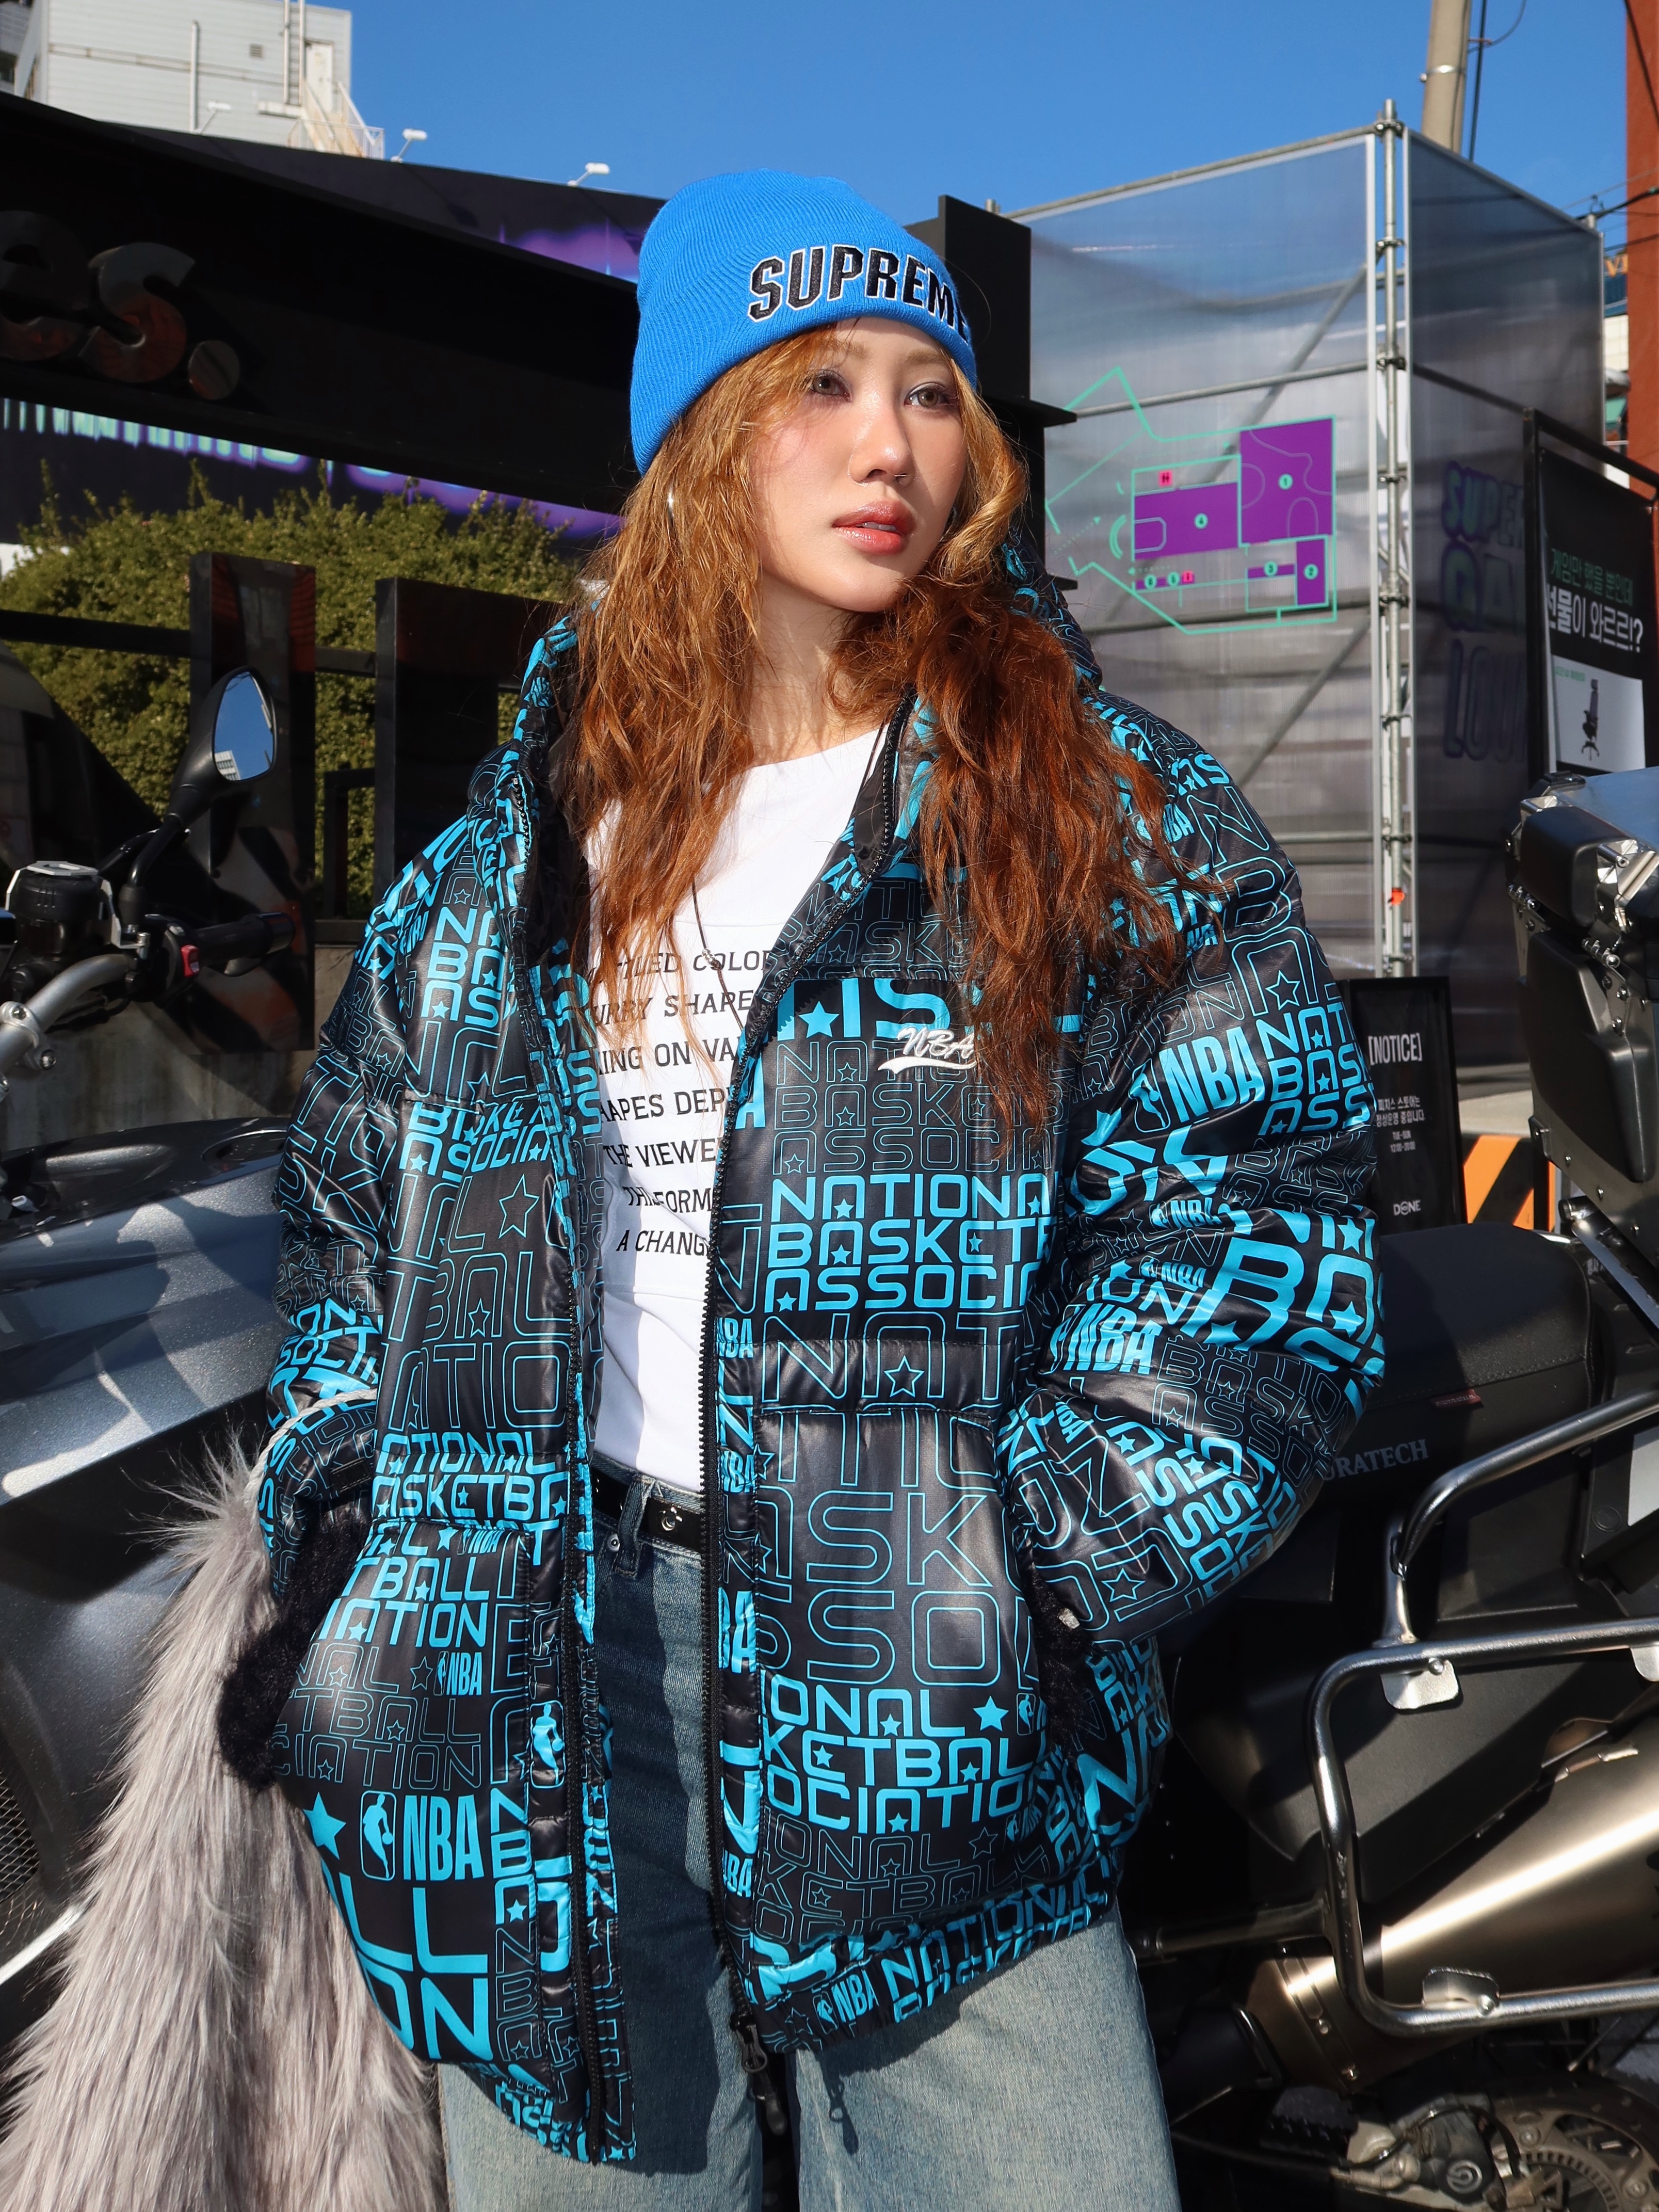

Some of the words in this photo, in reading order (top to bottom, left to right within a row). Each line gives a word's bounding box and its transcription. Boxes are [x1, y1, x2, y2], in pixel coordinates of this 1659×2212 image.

[654, 1040, 691, 1067] ON
[1367, 1032, 1423, 1066] [NOTICE]
[1159, 1025, 1266, 1124] NBA
[603, 1144, 634, 1168] THE
[635, 1137, 722, 1167] VIEWE
[616, 1229, 630, 1252] A
[635, 1230, 711, 1257] CHANG
[446, 1652, 482, 1696] NBA
[403, 1794, 484, 1881] NBA
